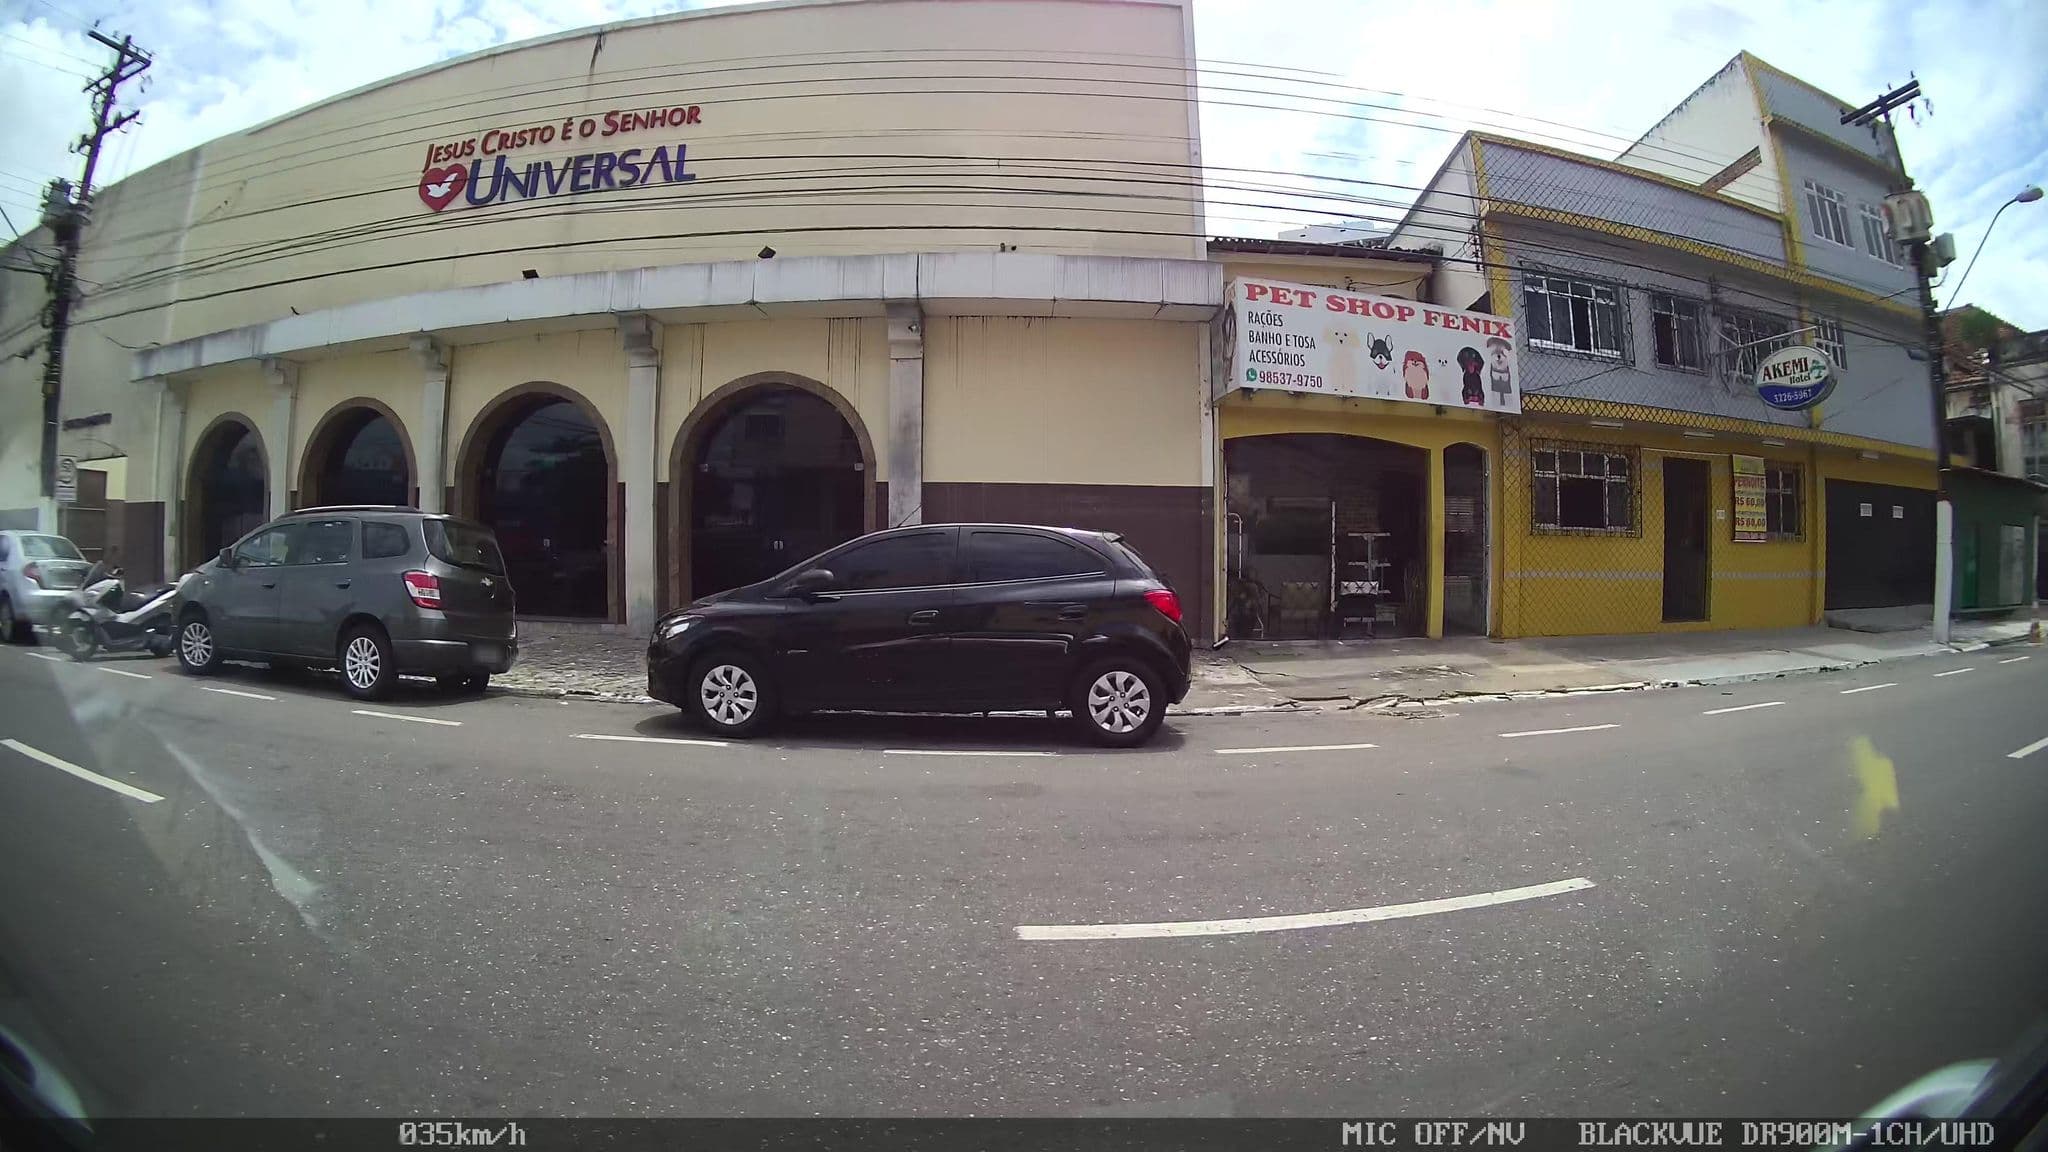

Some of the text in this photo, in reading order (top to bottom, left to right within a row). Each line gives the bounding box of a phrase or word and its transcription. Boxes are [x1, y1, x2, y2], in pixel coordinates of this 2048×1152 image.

[422, 105, 702, 173] JESUS CRISTO É O SENHOR
[465, 143, 697, 206] UNIVERSAL
[1244, 283, 1513, 339] PET SHOP FENIX
[1248, 309, 1283, 328] RAÇÕES
[1248, 330, 1316, 350] BANHO E TOSA
[1249, 347, 1306, 367] ACESSÓRIOS
[1763, 356, 1809, 382] AKEMI
[1790, 372, 1811, 385] Hotel
[1259, 371, 1323, 388] 98537-9750
